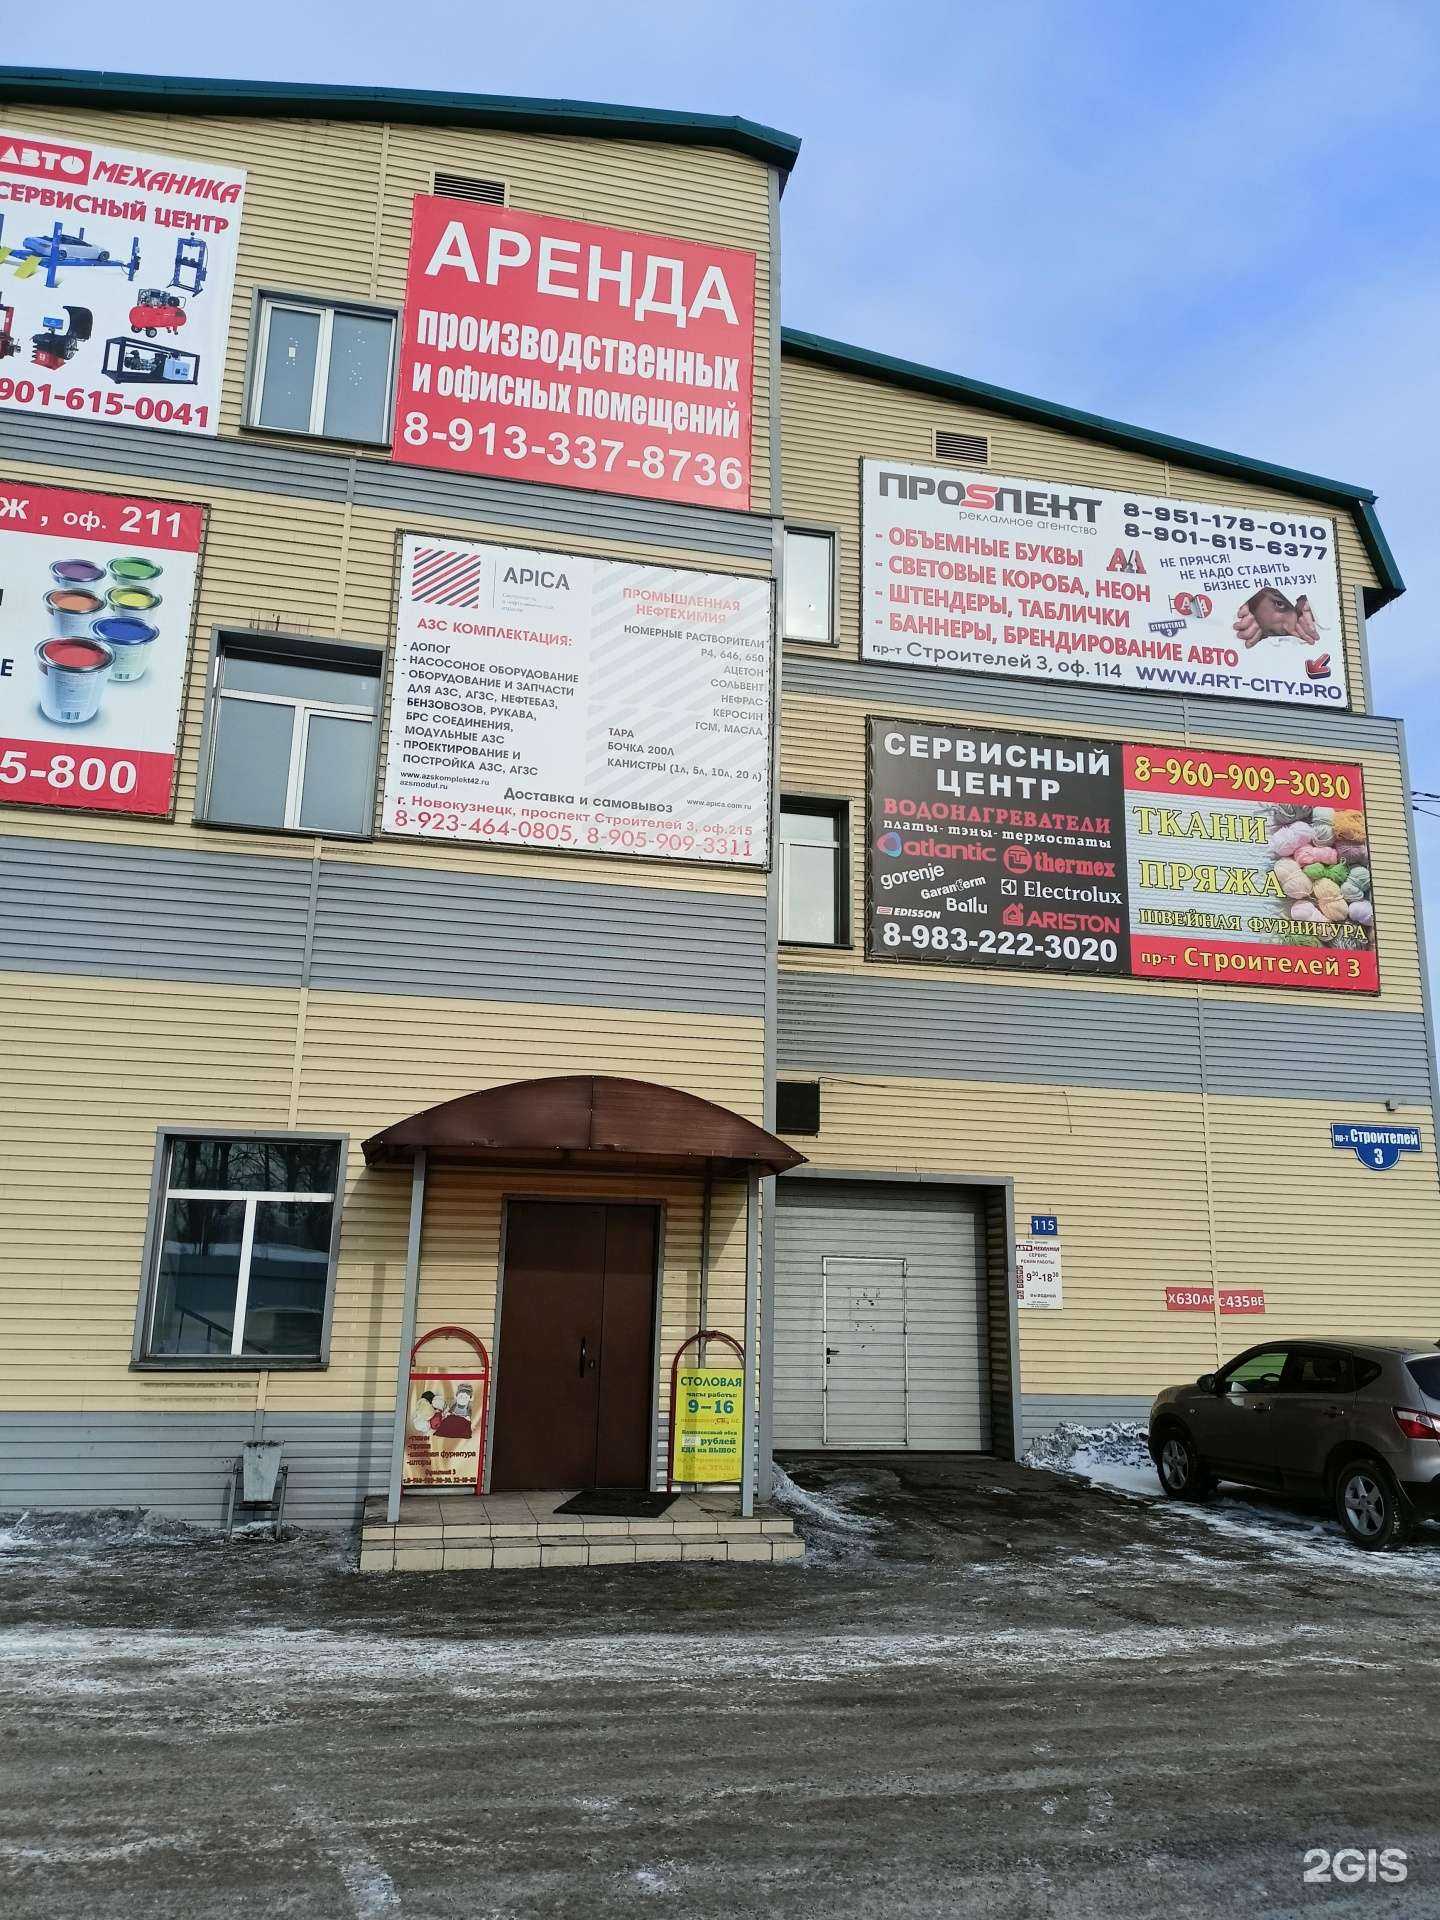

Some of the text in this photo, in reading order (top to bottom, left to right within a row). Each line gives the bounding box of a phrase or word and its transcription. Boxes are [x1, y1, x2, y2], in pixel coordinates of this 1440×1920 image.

[92, 160, 242, 204] МЕХАНИКА
[0, 181, 229, 234] СЕРВИСНЫЙ ЦЕНТР
[424, 220, 740, 328] АРЕНДА
[437, 365, 571, 414] офисных
[577, 386, 740, 439] помещений
[403, 411, 743, 490] 8-913-337-8736
[62, 506, 183, 538] оф. 211
[958, 511, 1098, 536] рекламное агентство
[1123, 502, 1327, 541] 8-951-178-0110
[888, 526, 1083, 568] ОБЪЕМНЫЕ БУКВЫ
[1123, 523, 1328, 561] 8-901-615-6377
[1159, 554, 1231, 568] НЕ ПРЯЧСЯ!
[1179, 562, 1291, 580] НЕ НАДО СТАВИТЬ
[888, 555, 1151, 603] СВЕТОВЫЕ КОРОБА, НЕОН
[1203, 573, 1317, 592] БИЗНЕС НА ПАУЗУ!
[623, 587, 741, 612] ПРОМЫШЛЕННАЯ
[888, 583, 1130, 629] ШТЕНДЕРЫ, ТАБЛИЧКИ
[635, 604, 727, 625] НЕФТЕХИМИЯ
[417, 617, 573, 648] АЗС КОМПЛЕКТАЦИЯ:
[624, 624, 765, 649] НОМЕРНЫЕ РАСТВОРИТЕЛИ
[888, 612, 1239, 668] БАННЕРЫ, БРЕНДИРОВАНИЕ АВТО
[408, 669, 575, 697] ОБОРУДОВАНИЕ И ЗАПЧАСТИ
[409, 655, 580, 684] НАСОСОНОЕ ОБОРУДОВАНИЕ
[723, 665, 764, 678] АЦЕТОН
[872, 641, 1343, 700] пр-т Строителей 3, оф. 114 WWW.ART-CITY.PRO
[407, 683, 558, 710] ДЛЯ АЗС, АГЗС, НЕФТЕБАЗ,
[710, 678, 765, 692] СОЛЬВЕНТ
[406, 697, 537, 721] БЕНЗОВОЗОВ, РУКАВА,
[721, 694, 764, 706] НЕФРАС
[406, 711, 514, 732] БРС СОЕДИНЕНИЯ,
[713, 708, 764, 721] КЕРОСИН
[405, 725, 505, 745] МОДУЛЬНЫЕ АЗС
[608, 727, 635, 739] ТАРА
[695, 721, 763, 737] ГСМ, МАСЛА
[403, 740, 521, 761] ПРОЕКТИРОВАНИЕ И
[607, 741, 645, 754] БОЧКА
[883, 732, 1111, 777] СЕРВИСНЫЙ
[402, 754, 539, 777] ПОСТРОЙКА АЗС, АГЗС
[607, 758, 666, 772] КАНИСТРЫ
[1133, 756, 1351, 800] 8-960-909-3030
[936, 768, 1061, 801] ЦЕНТР
[411, 795, 517, 817] Новокузнецк,
[521, 807, 591, 824] проспект
[594, 812, 682, 831] Строителей
[503, 787, 674, 814] Доставка и самовывоз
[883, 798, 1112, 835] ВОДОНАГРЕВАТЕЛИ
[1132, 805, 1269, 844] ТКАНИ
[394, 809, 753, 857] 8-923-464-0805, 8-905-909-3311
[1001, 829, 1112, 849] термостаты
[902, 837, 1117, 878] atlantic thermex
[880, 862, 945, 890] gorenje
[1138, 860, 1287, 899] ПРЯЖА
[946, 897, 989, 915] Ballu
[1023, 880, 1124, 905] Electrolux
[893, 906, 942, 920] EDISSON
[1026, 910, 1121, 934] ARISTON
[1138, 907, 1369, 943] ШВЕЙНАЯ ФУРНИТУРА
[882, 922, 1119, 963] 8-983-222-3020
[1141, 946, 1361, 978] пр-т Строителей 3
[1350, 1128, 1419, 1146] Строителей
[1373, 1147, 1384, 1165] 3
[1033, 1219, 1054, 1230] 115
[680, 1376, 741, 1387] СТОЛОВАЯ
